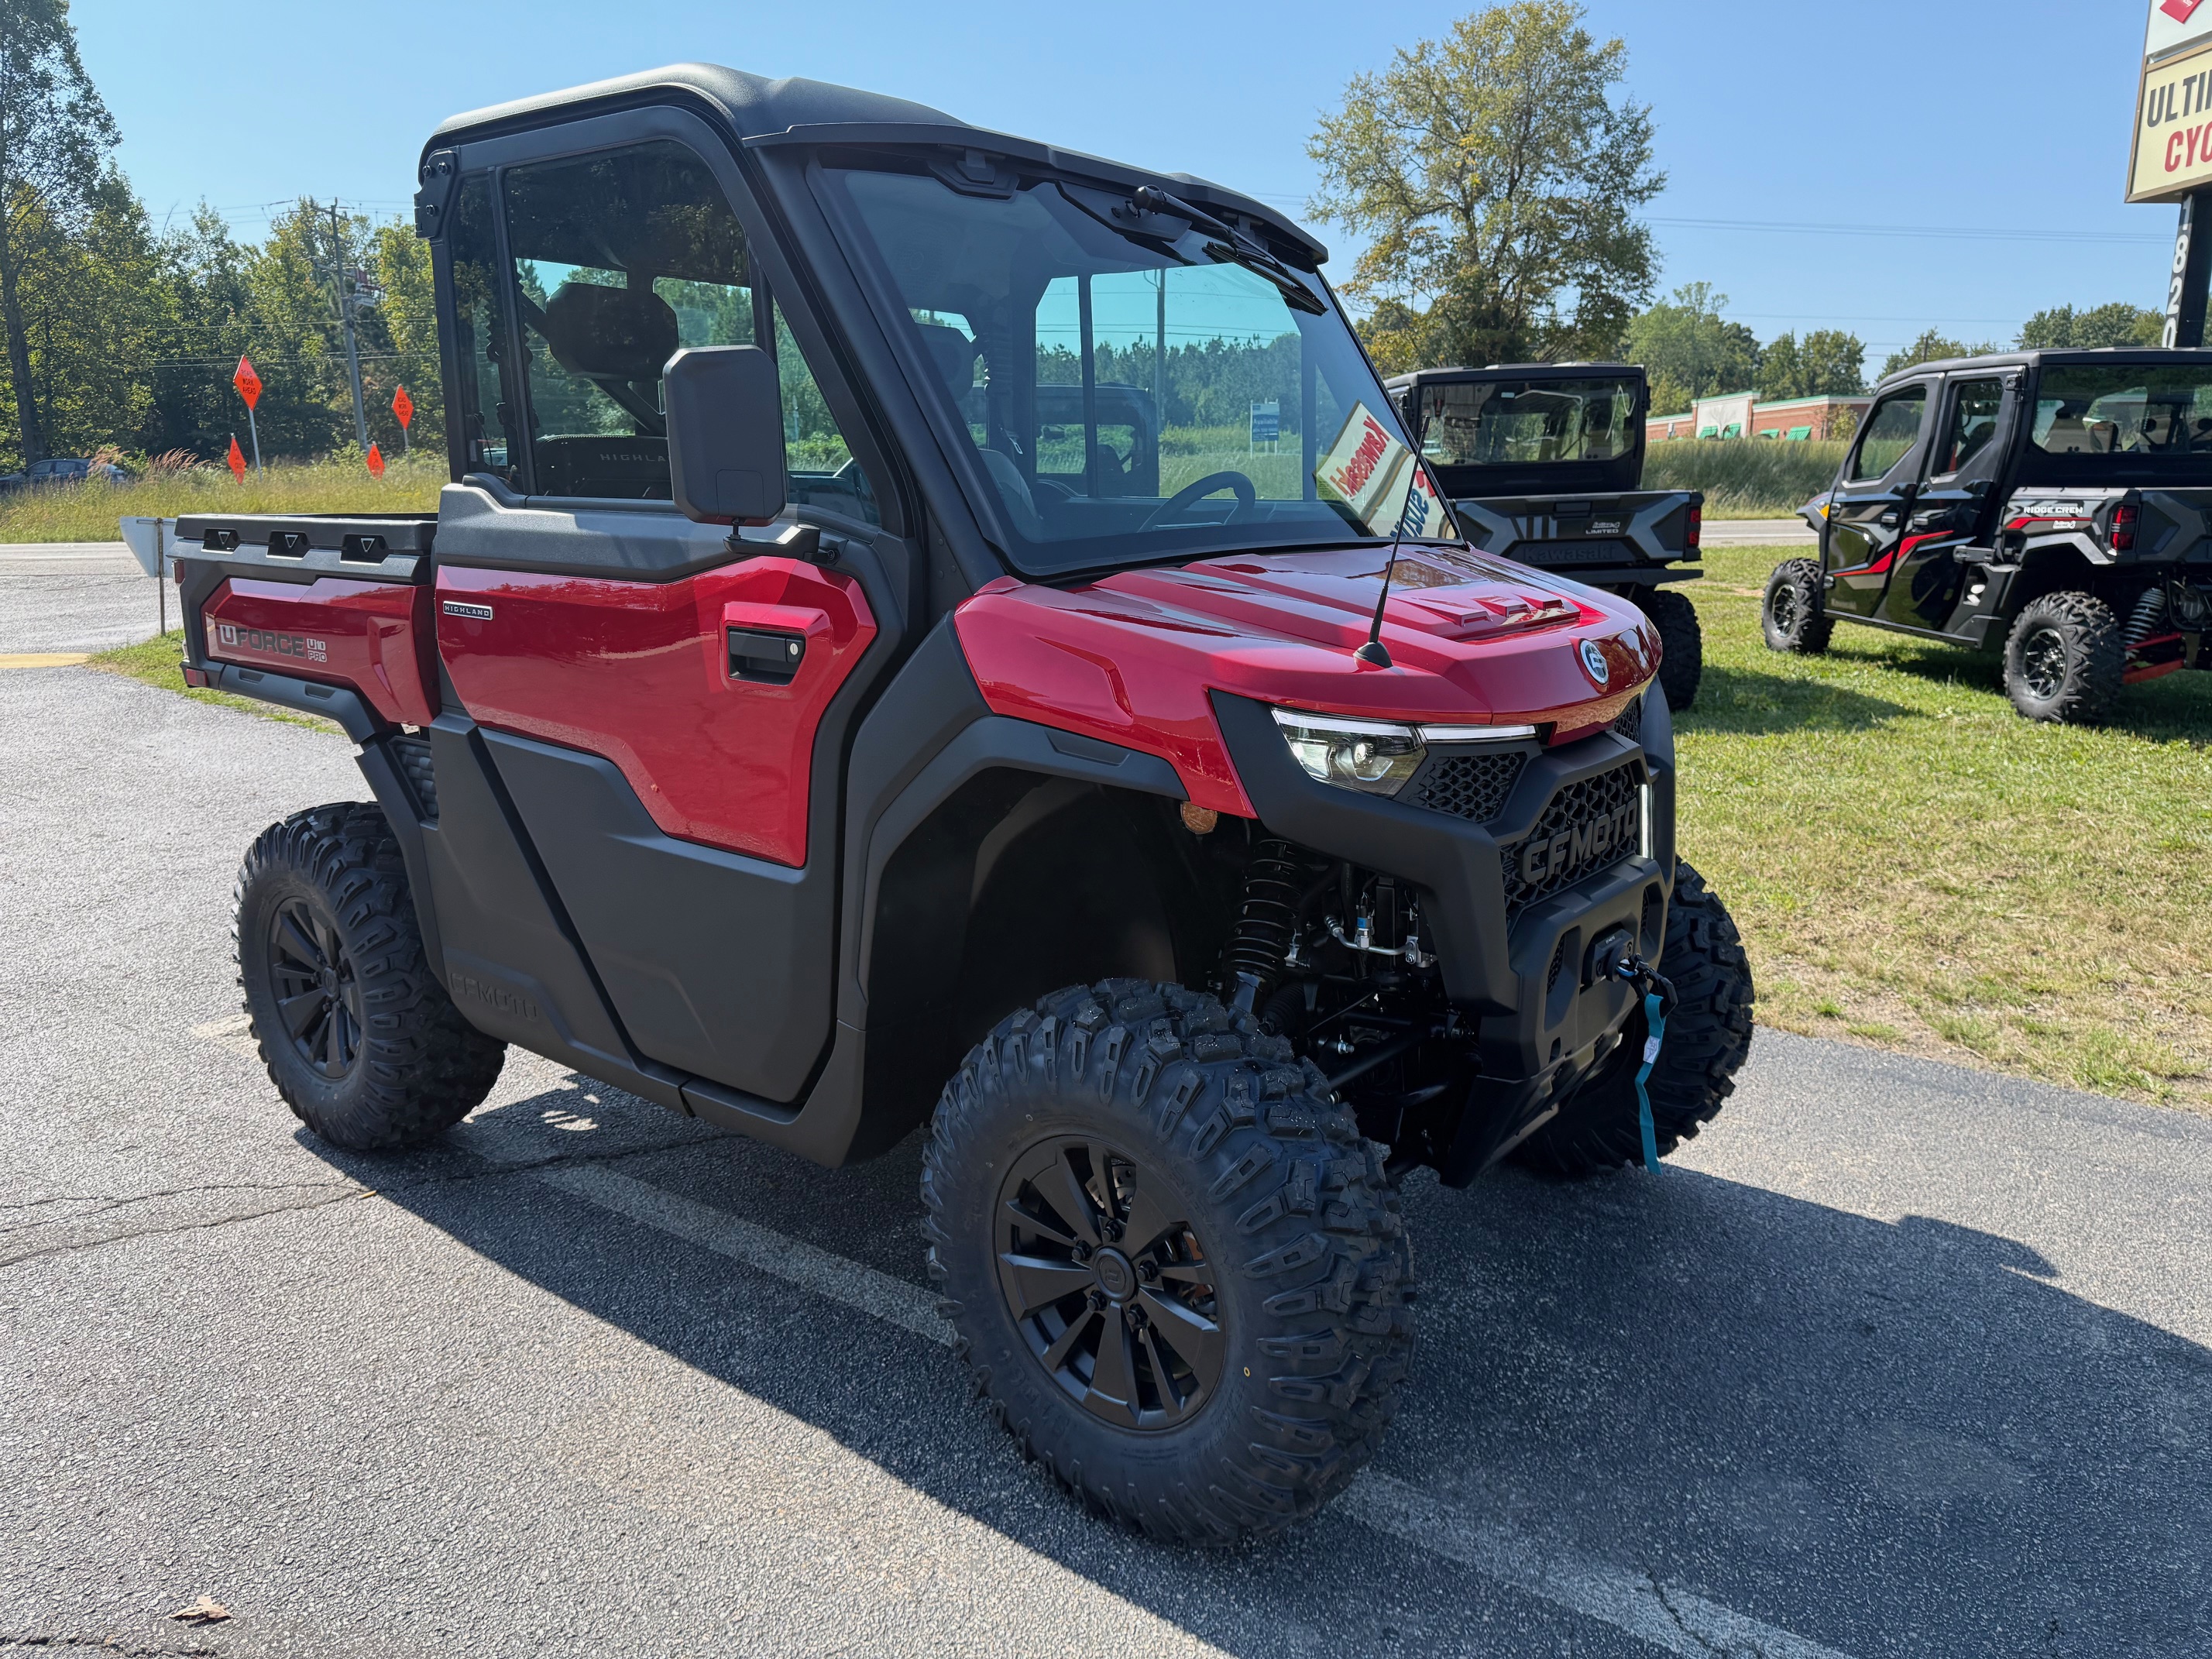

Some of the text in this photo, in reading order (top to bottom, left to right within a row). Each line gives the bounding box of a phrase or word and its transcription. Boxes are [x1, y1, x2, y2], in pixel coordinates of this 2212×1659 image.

[2161, 194, 2193, 350] 1820
[599, 453, 666, 462] HIGHLA
[1523, 544, 1616, 562] Kawasaki
[444, 603, 490, 618] HIGHLAND
[219, 623, 326, 658] UFORCE U10
[307, 651, 328, 663] PRO
[1521, 797, 1638, 884] CFMOTO
[449, 972, 539, 1023] CFMOTO
